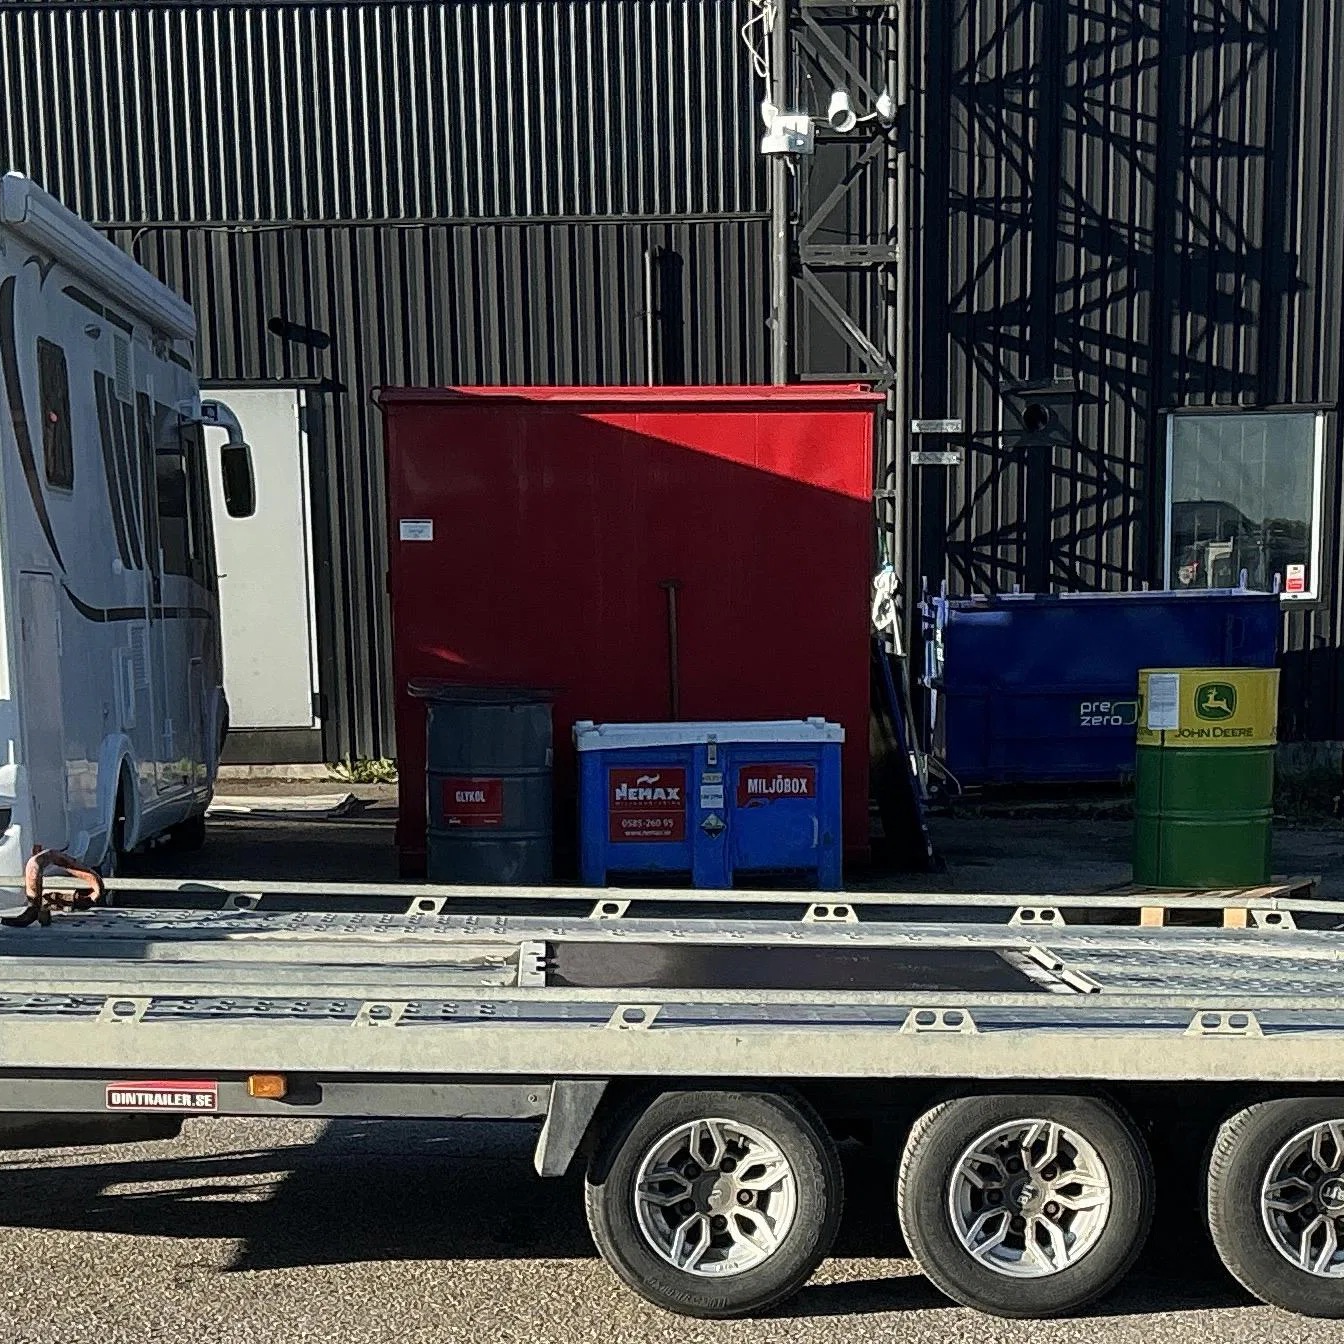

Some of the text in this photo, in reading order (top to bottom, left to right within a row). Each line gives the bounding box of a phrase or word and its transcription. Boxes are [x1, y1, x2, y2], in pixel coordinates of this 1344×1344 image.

[1080, 701, 1111, 715] pre
[1079, 715, 1122, 726] zero
[1175, 726, 1254, 738] JOHN DEERE
[747, 774, 808, 794] MILJÖBOX
[455, 790, 486, 803] GLYKOL
[111, 1092, 213, 1107] DINTRAILER.SE
